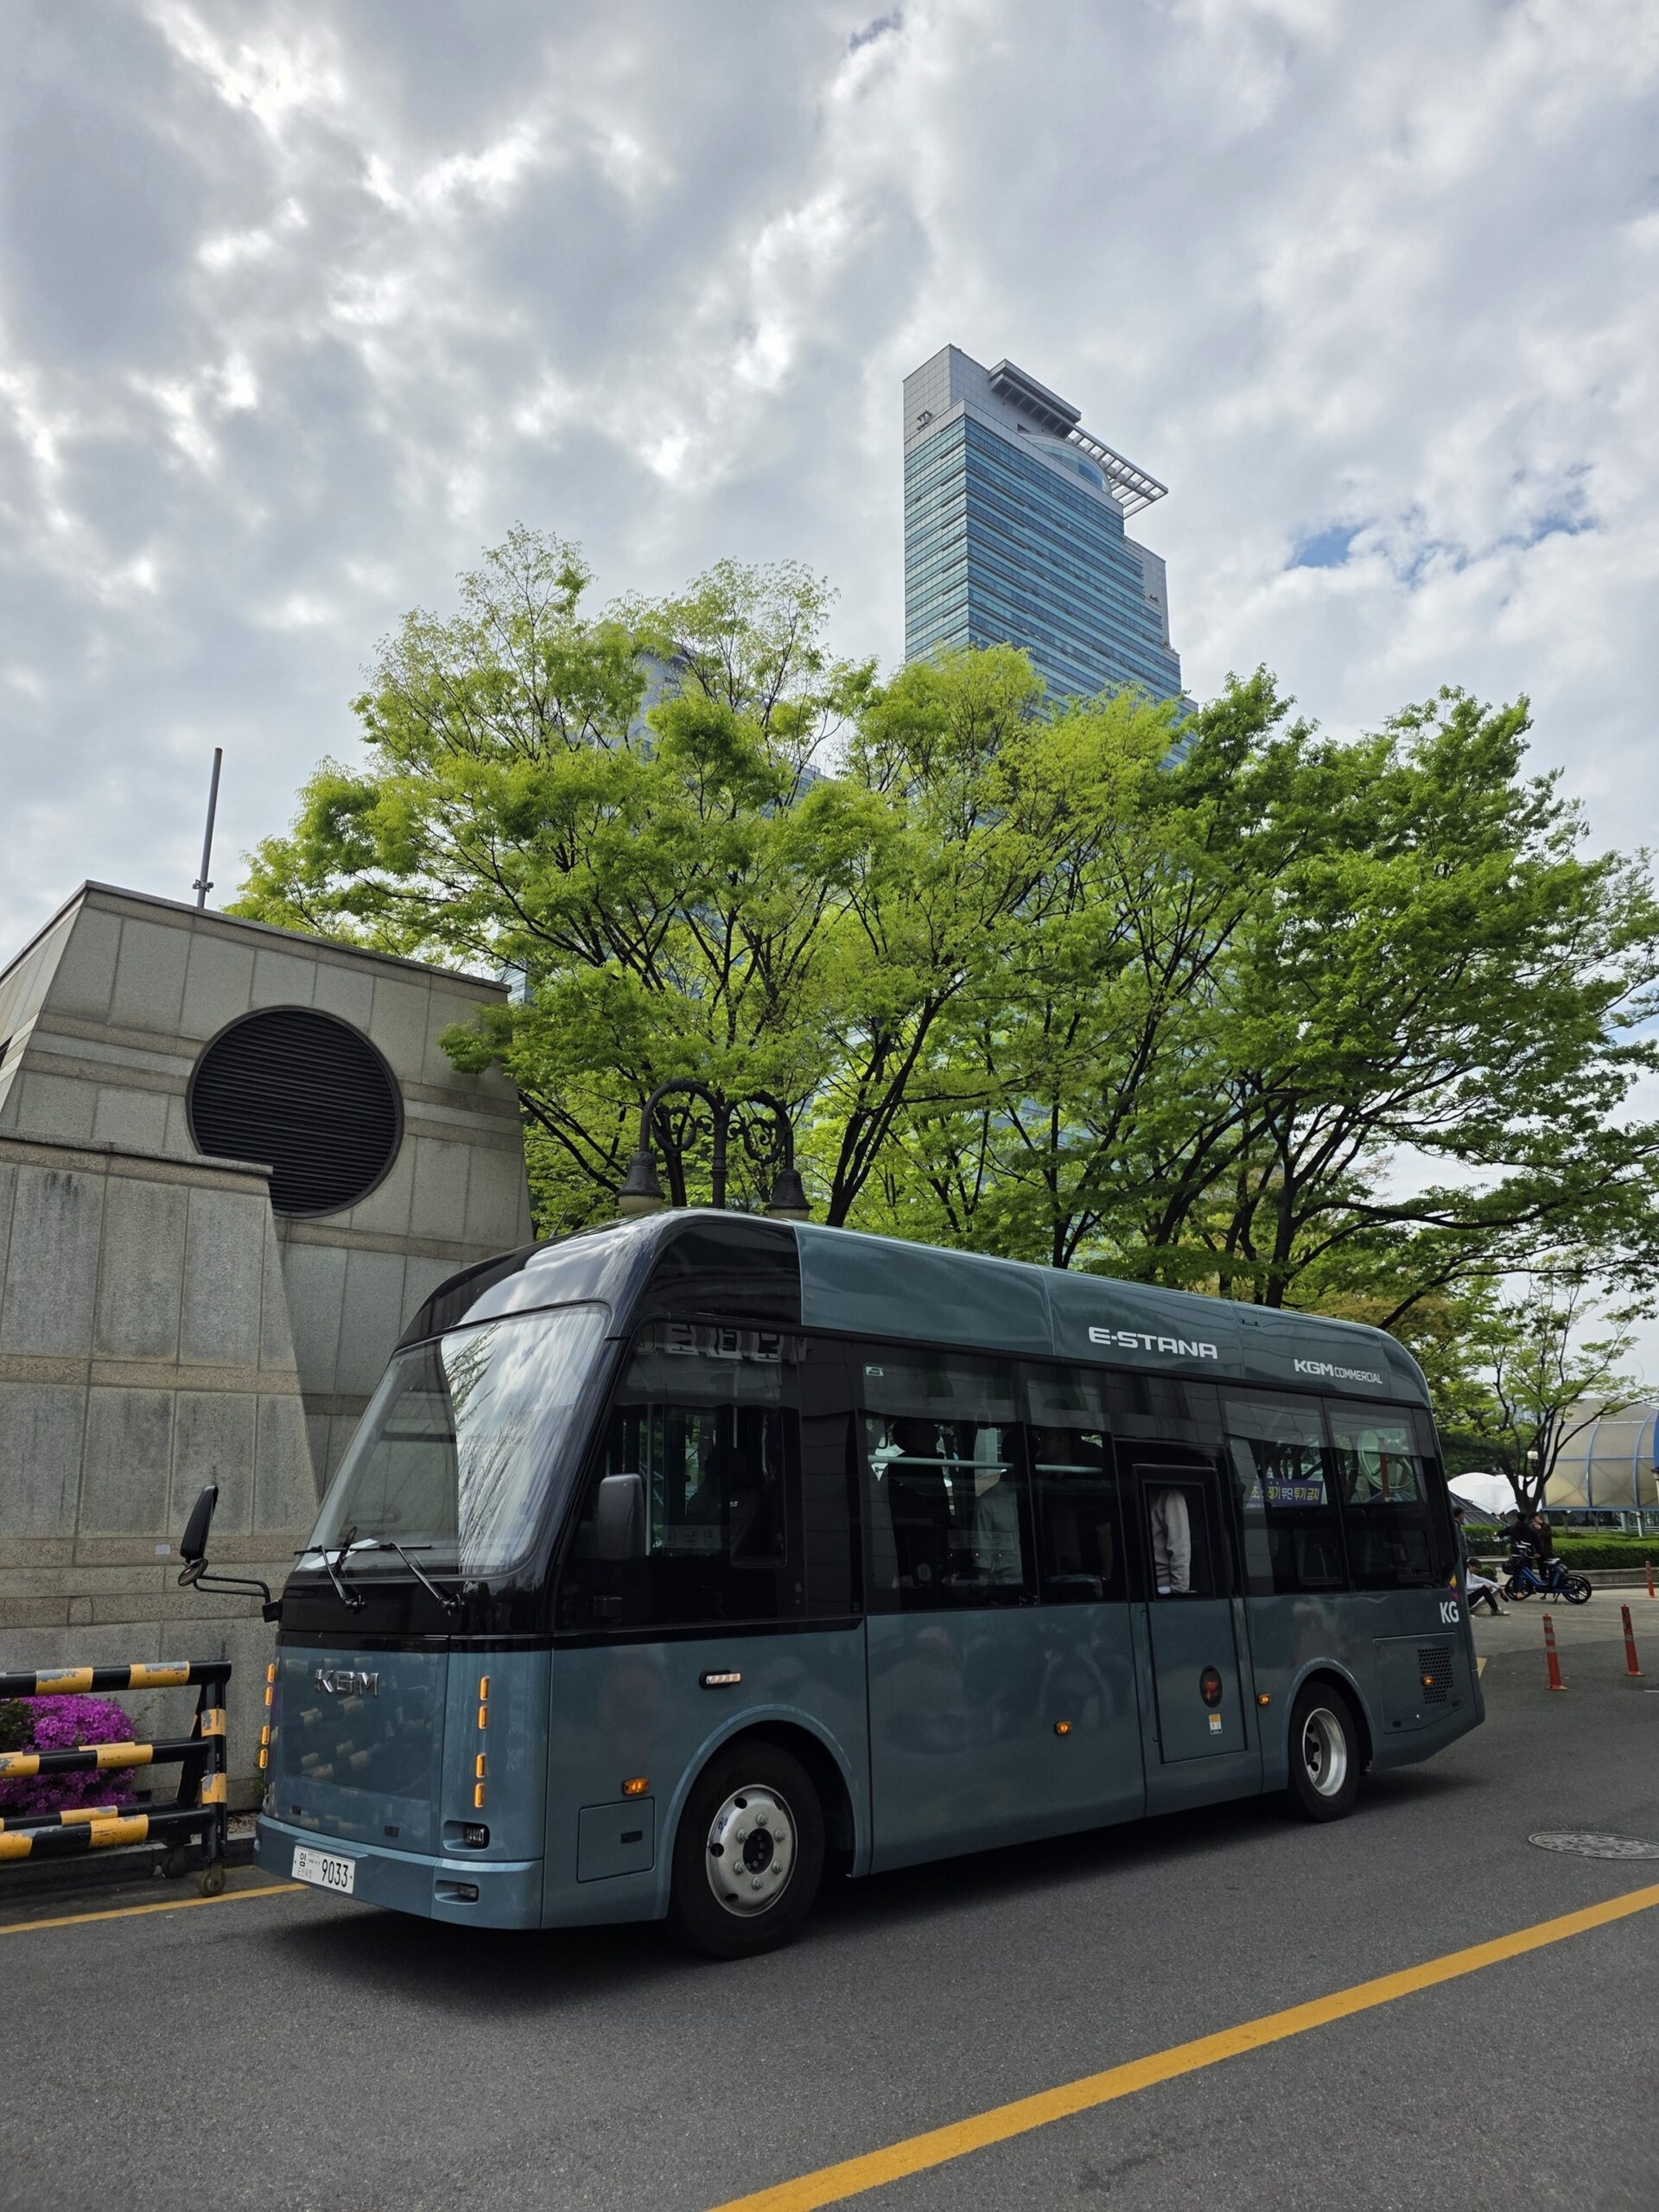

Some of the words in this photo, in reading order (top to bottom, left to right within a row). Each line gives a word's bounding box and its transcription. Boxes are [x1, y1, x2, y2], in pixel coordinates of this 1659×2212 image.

[1089, 1326, 1218, 1359] E-STANA
[1294, 1359, 1334, 1376] KGM
[1440, 1601, 1459, 1624] KG
[315, 1669, 378, 1696] KGM
[321, 1859, 349, 1888] 9033
